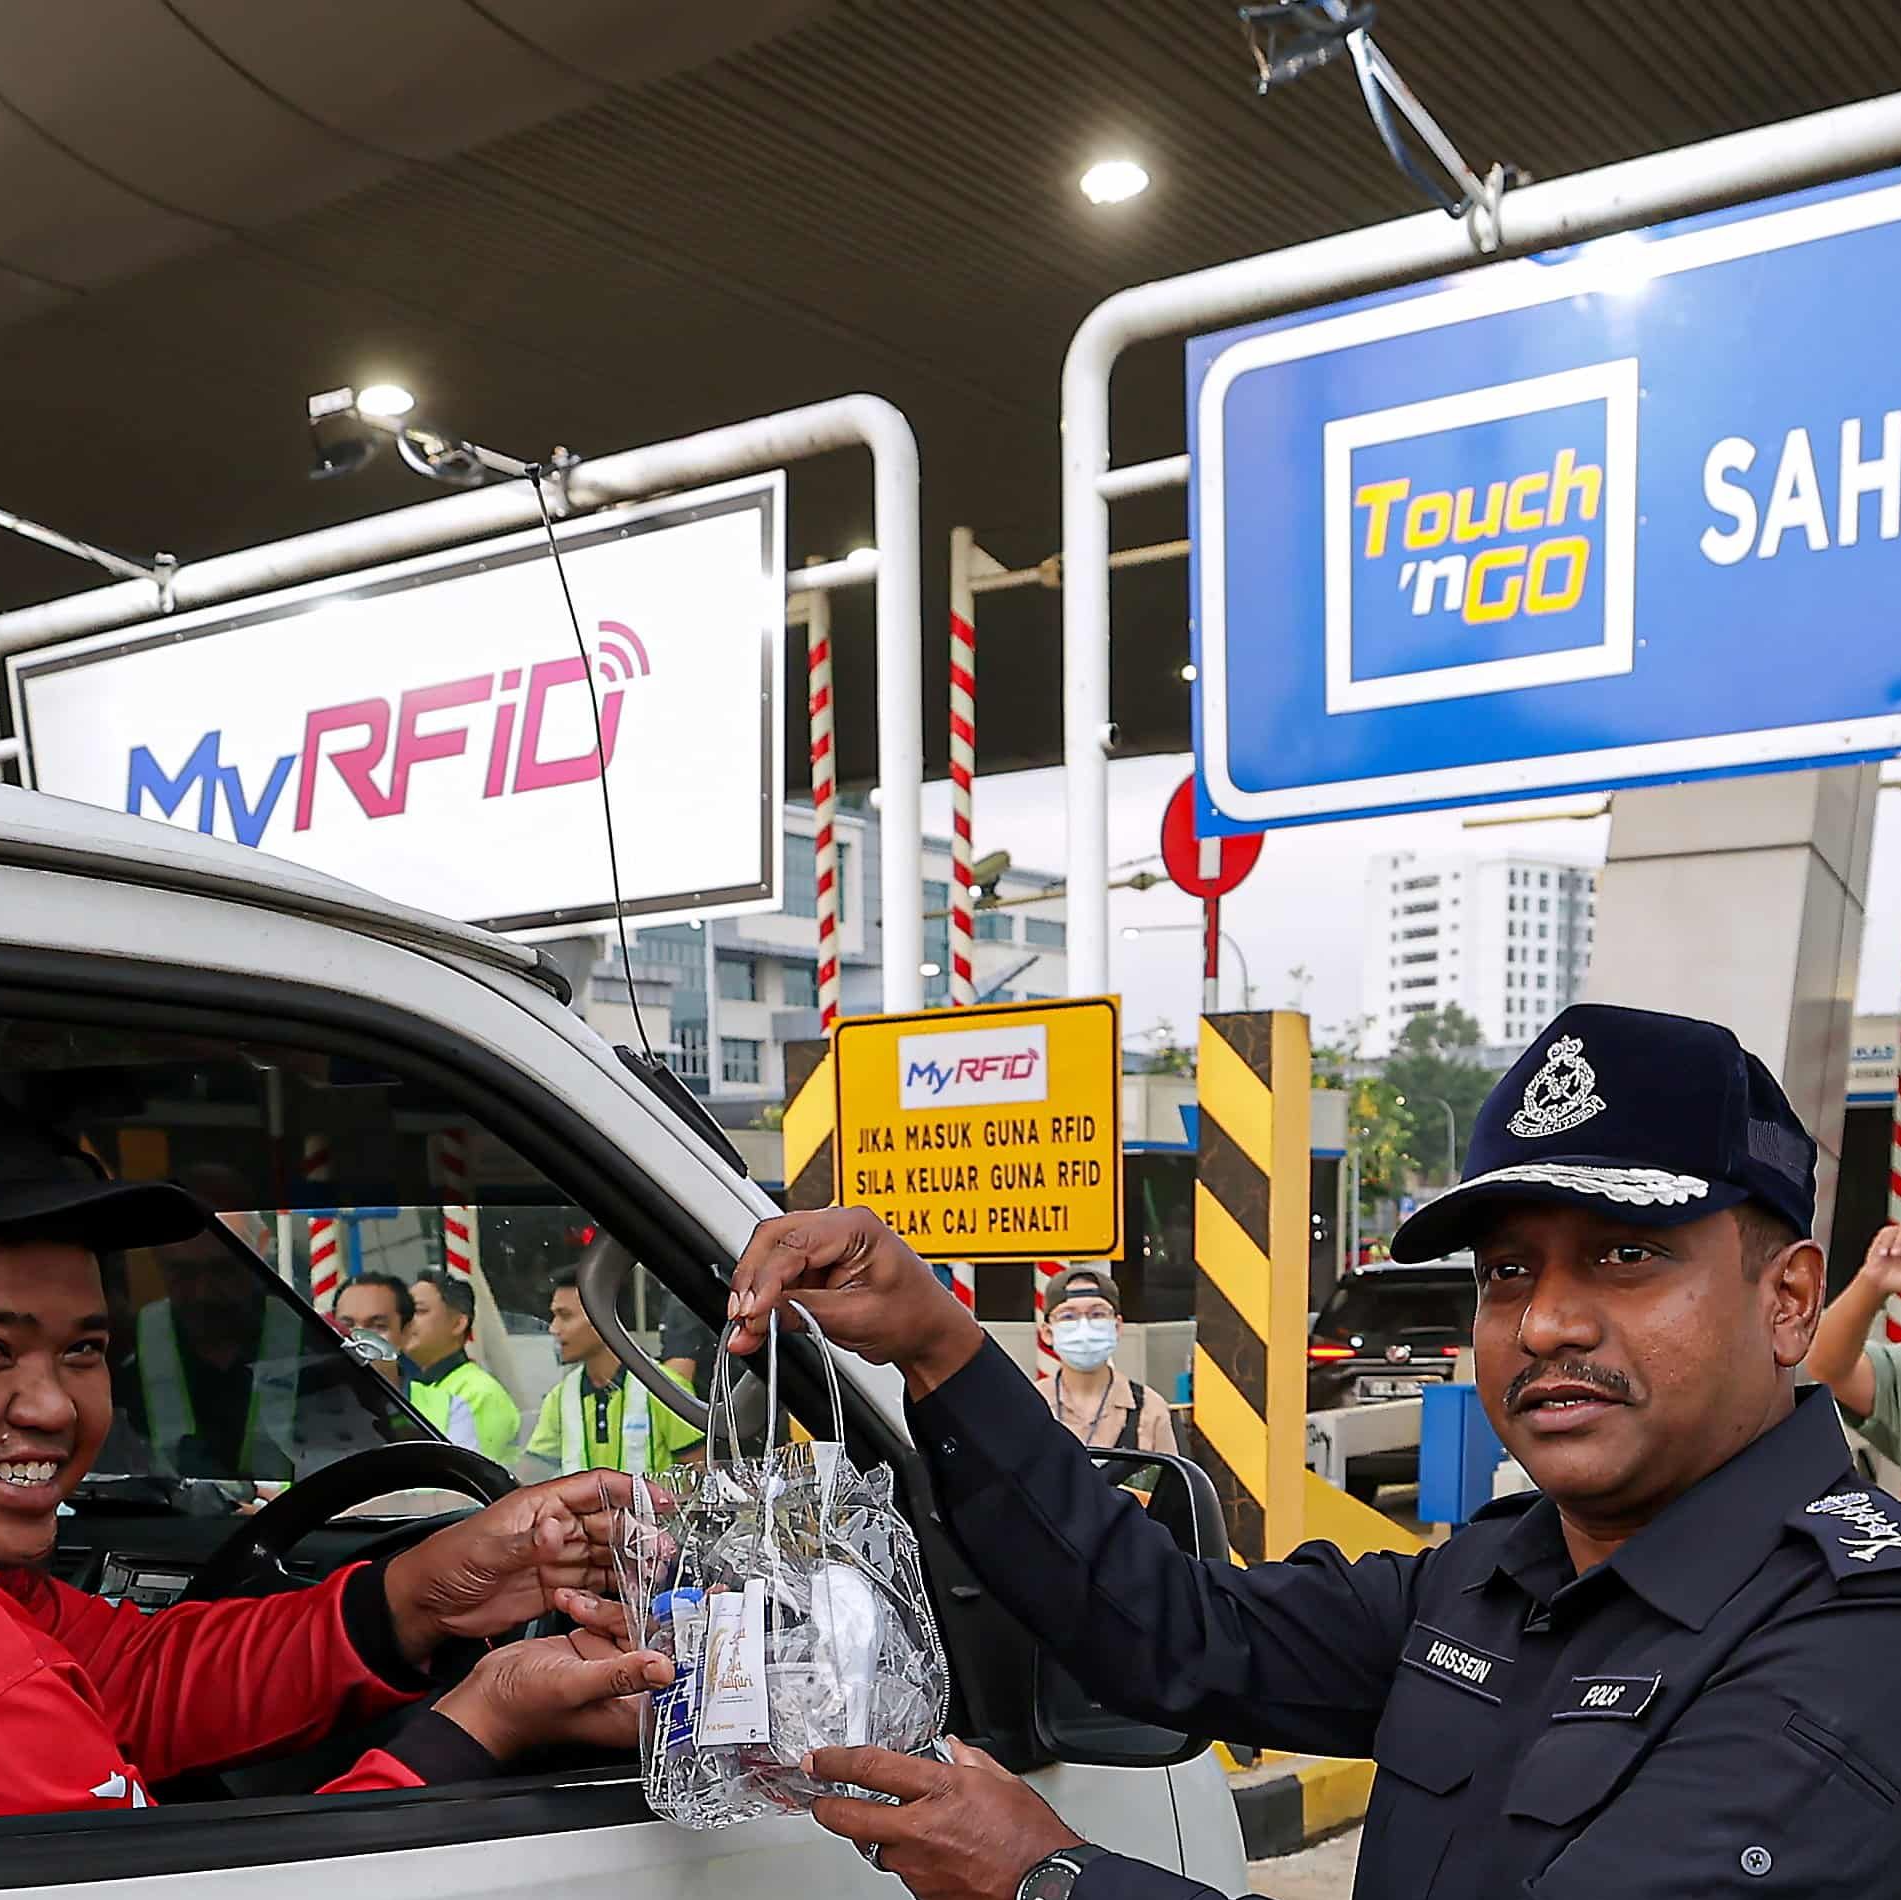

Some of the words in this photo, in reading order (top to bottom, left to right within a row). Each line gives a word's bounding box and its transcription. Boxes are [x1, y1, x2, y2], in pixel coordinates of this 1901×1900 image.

[1355, 448, 1603, 558] Touch
[857, 1127, 895, 1154] JIKA
[905, 1121, 972, 1151] MASUK
[984, 1119, 1040, 1147] GUNA
[1051, 1115, 1096, 1144] RFID
[856, 1169, 895, 1195] SILA
[906, 1165, 979, 1193] KELUAR
[991, 1162, 1046, 1190] GUNA
[1058, 1160, 1100, 1188] RFID
[943, 1207, 977, 1235] CAJ
[988, 1205, 1069, 1233] PENALTI
[1426, 1640, 1492, 1685] HUSSEIN
